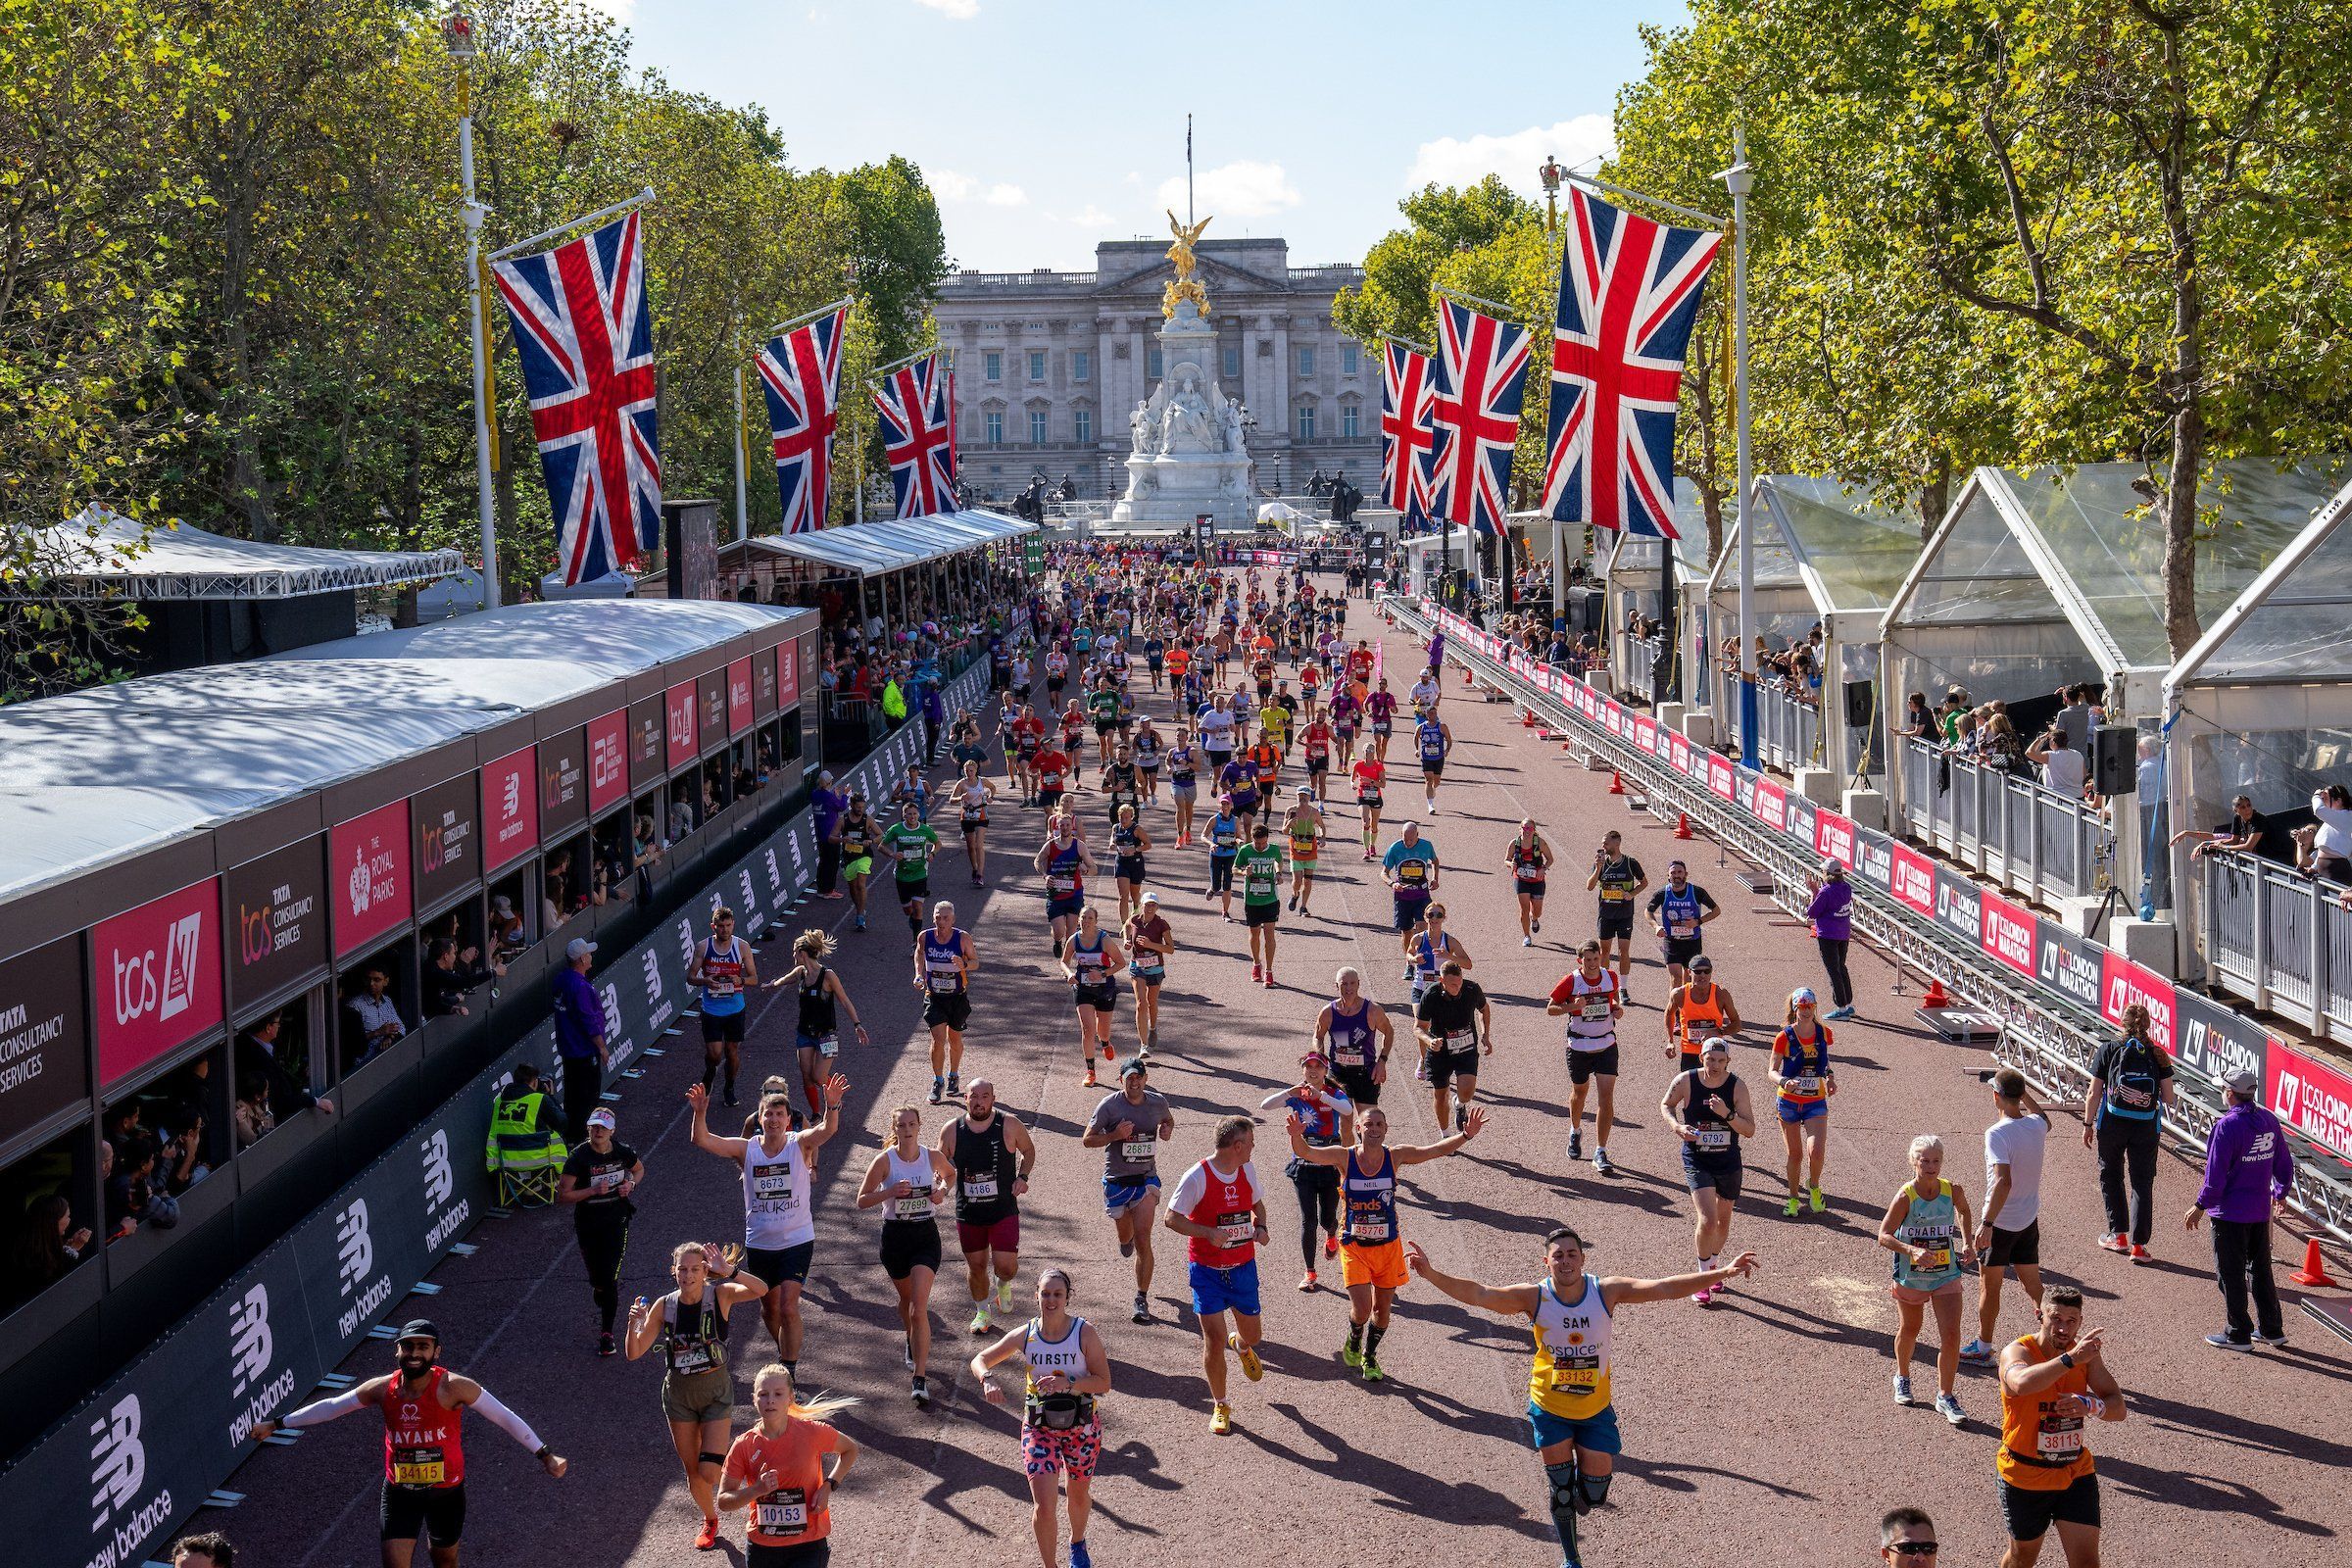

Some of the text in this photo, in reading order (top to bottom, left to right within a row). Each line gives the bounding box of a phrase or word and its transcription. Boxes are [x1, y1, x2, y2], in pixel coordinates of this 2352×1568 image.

[671, 706, 683, 744] tcs
[560, 758, 569, 772] TATA
[545, 767, 561, 810] tcs
[443, 808, 456, 828] TATA
[370, 835, 380, 851] THE
[443, 819, 470, 846] CONSULTANCY
[422, 823, 444, 874] tcs
[444, 843, 464, 865] SERVICES
[1872, 846, 1890, 871] LONDON
[371, 849, 395, 876] ROYAL
[1865, 858, 1889, 885] MARATHON
[372, 877, 395, 906] PARKS
[1914, 865, 1932, 891] LONDON
[272, 883, 292, 907] TATA
[1906, 878, 1932, 907] MARATHON
[1950, 883, 1980, 921] tcs LONDON
[272, 895, 314, 930] CONSULTANCY
[1950, 905, 1980, 939] MARATHON
[240, 904, 272, 965] tcs
[273, 921, 301, 953] SERVICES
[1998, 909, 2031, 950] tcs LONDON
[927, 947, 955, 959] Stroke
[1998, 932, 2031, 969] MARATHON
[2058, 942, 2098, 981] tcs LONDON
[114, 947, 157, 1026] tcs
[2059, 967, 2098, 1005] MARATHON
[657, 999, 673, 1024] balance
[1585, 1005, 1606, 1015] 26969
[2128, 980, 2170, 1020] tcs LONDON
[0, 1003, 27, 1036] TATA
[0, 1013, 65, 1064] CONSULTANCY
[2146, 1019, 2171, 1051] THON
[2207, 1022, 2260, 1072] tcs LONDON
[0, 1052, 44, 1094] SERVICES
[2302, 1074, 2320, 1104] tcs
[1126, 1144, 1152, 1154] 26878
[1703, 1133, 1725, 1144] 6792
[760, 1177, 784, 1189] 8673
[969, 1184, 991, 1195] 4186
[752, 1195, 800, 1214] EdUKaid
[900, 1199, 927, 1211] 27699
[425, 1198, 469, 1253] new balance
[1355, 1225, 1385, 1236] 35776
[1907, 1224, 1954, 1237] CHARLIE
[338, 1274, 392, 1340] new balance
[1562, 1316, 1591, 1329] SAM
[1031, 1352, 1077, 1365] KIRSTY
[1557, 1371, 1593, 1383] 33132
[229, 1368, 295, 1448] new balance
[2044, 1433, 2081, 1448] 38113
[400, 1464, 438, 1480] 34115
[84, 1489, 173, 1568] new balance
[762, 1508, 801, 1522] 10153
